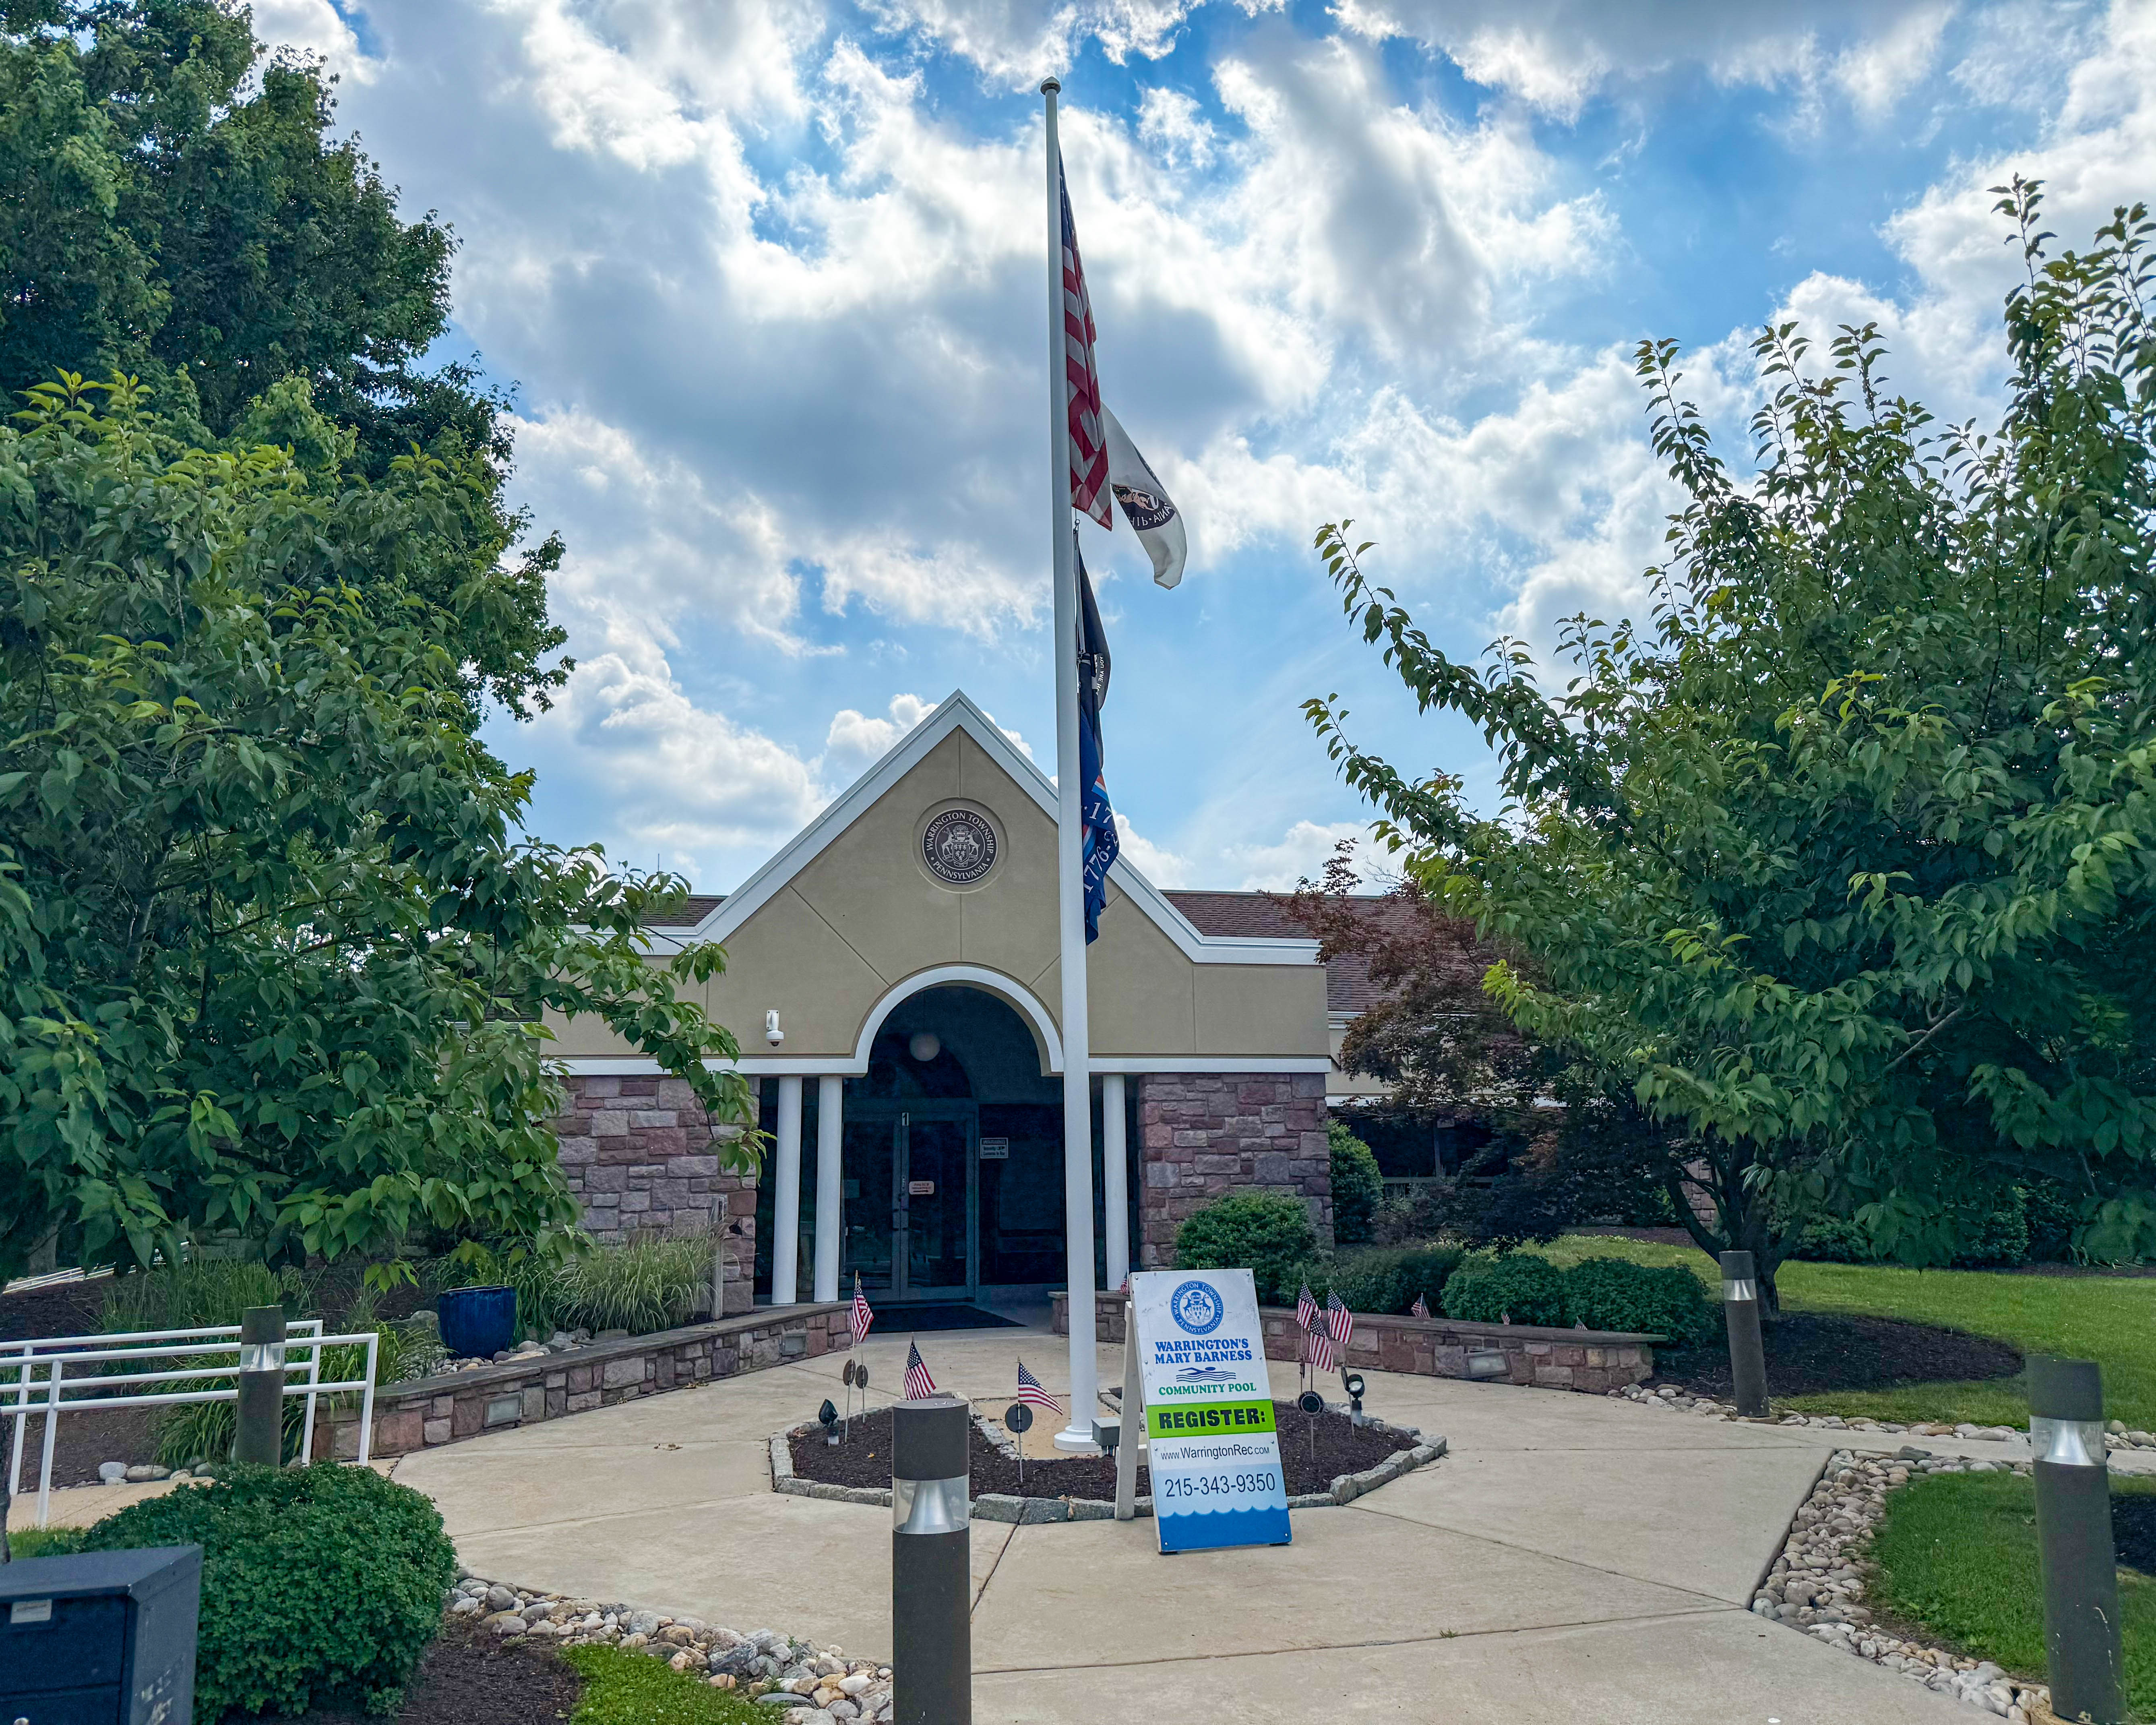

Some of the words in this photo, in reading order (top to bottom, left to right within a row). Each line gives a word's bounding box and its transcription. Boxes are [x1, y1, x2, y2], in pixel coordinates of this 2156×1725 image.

[926, 812, 966, 851] WARRINGTON
[968, 813, 994, 854] TOWNSHIP
[933, 860, 989, 879] PENNSYLVANIA
[903, 1113, 907, 1125] 1
[1173, 1282, 1199, 1315] WARRINGTON
[1202, 1284, 1222, 1314] TOWNSHIP
[1178, 1317, 1219, 1333] PENNSYLVANIA
[1155, 1338, 1249, 1352] WARRINGTON'S
[1155, 1352, 1191, 1364] MARY
[1194, 1350, 1252, 1362] BARNESS
[1159, 1384, 1225, 1396] COMMUNITY
[1228, 1382, 1257, 1392] POOL
[1159, 1408, 1266, 1429] REGISTER:
[1165, 1472, 1275, 1497] 215-343-9350
